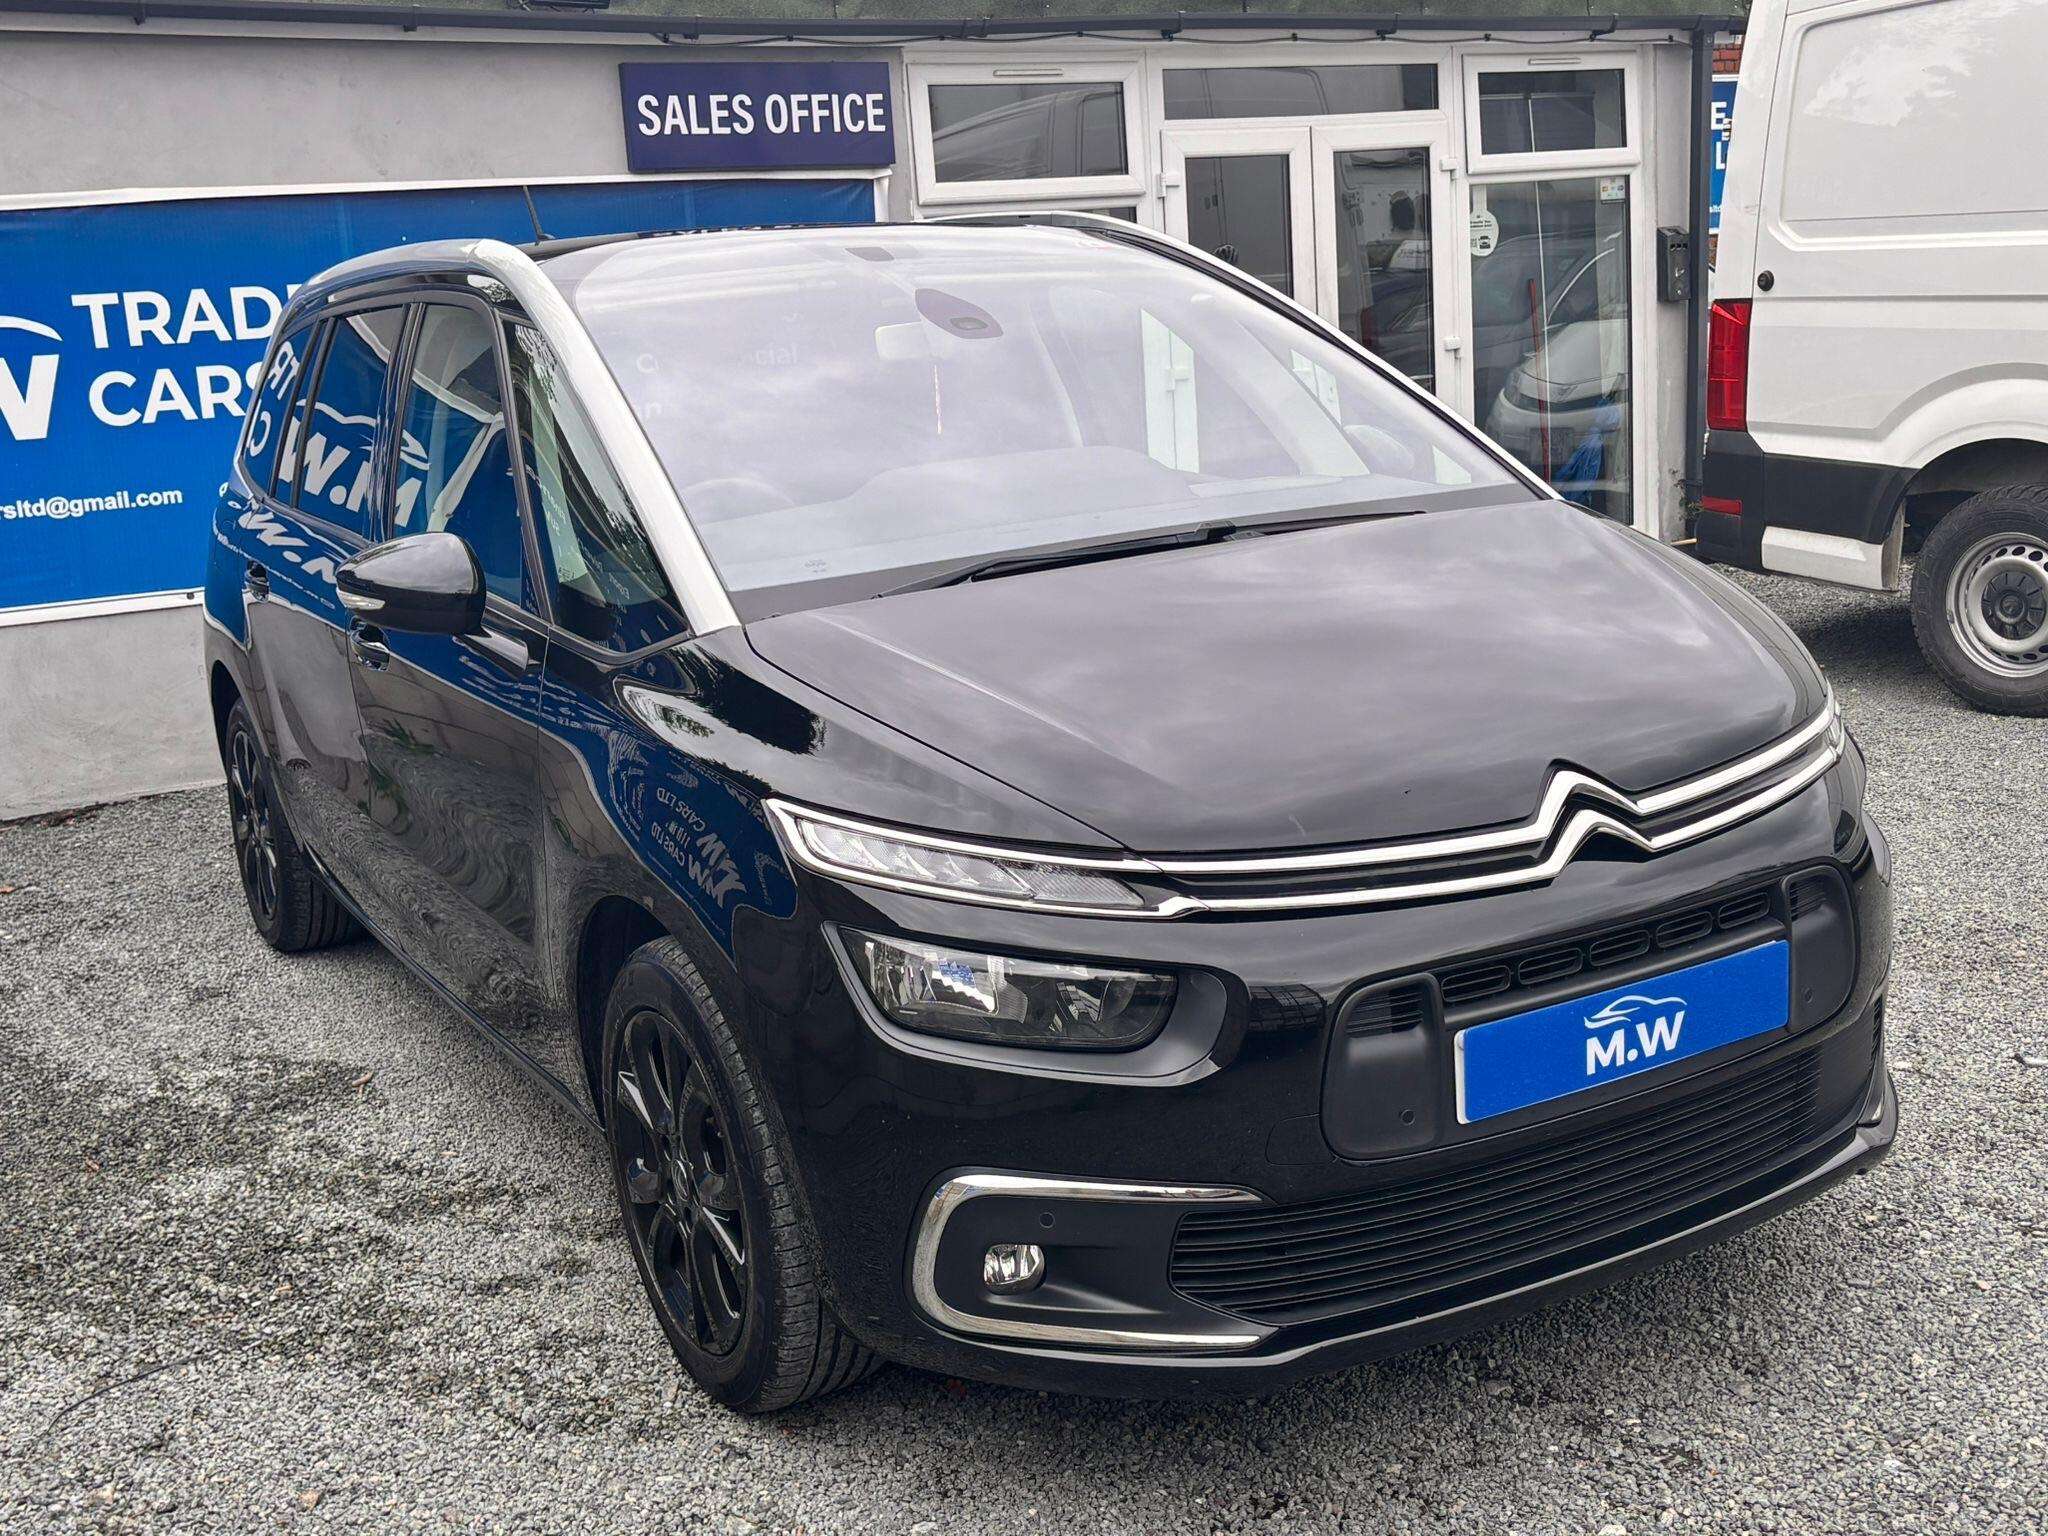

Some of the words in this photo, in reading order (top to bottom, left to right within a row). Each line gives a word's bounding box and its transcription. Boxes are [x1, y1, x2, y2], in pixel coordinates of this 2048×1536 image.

[637, 94, 755, 136] SALES
[765, 93, 886, 134] OFFICE
[71, 283, 304, 350] TRAD
[1586, 1010, 1685, 1075] M.W
